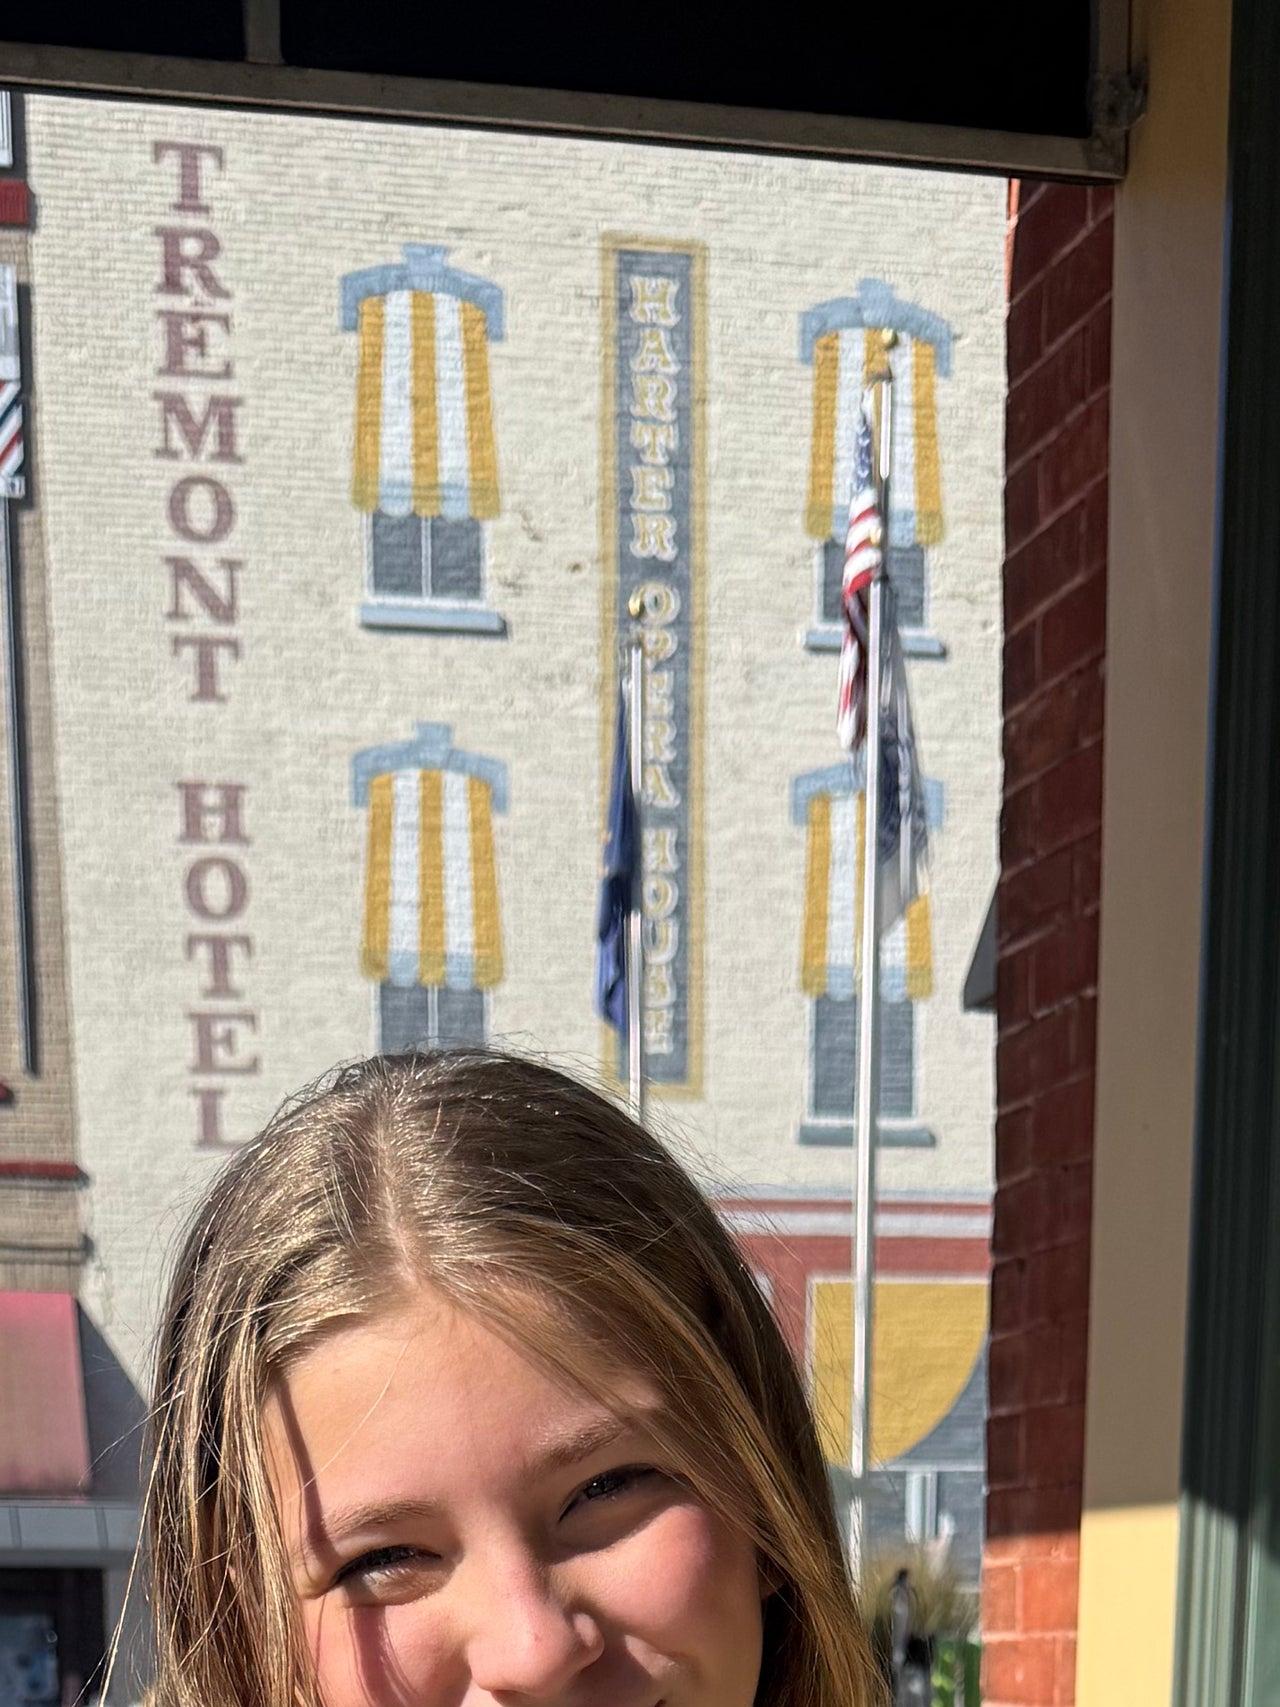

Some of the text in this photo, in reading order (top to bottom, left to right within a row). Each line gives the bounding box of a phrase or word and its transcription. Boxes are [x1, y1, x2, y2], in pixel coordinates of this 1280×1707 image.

[152, 141, 261, 1151] TREMONT HOTEL
[629, 275, 681, 562] HARTER
